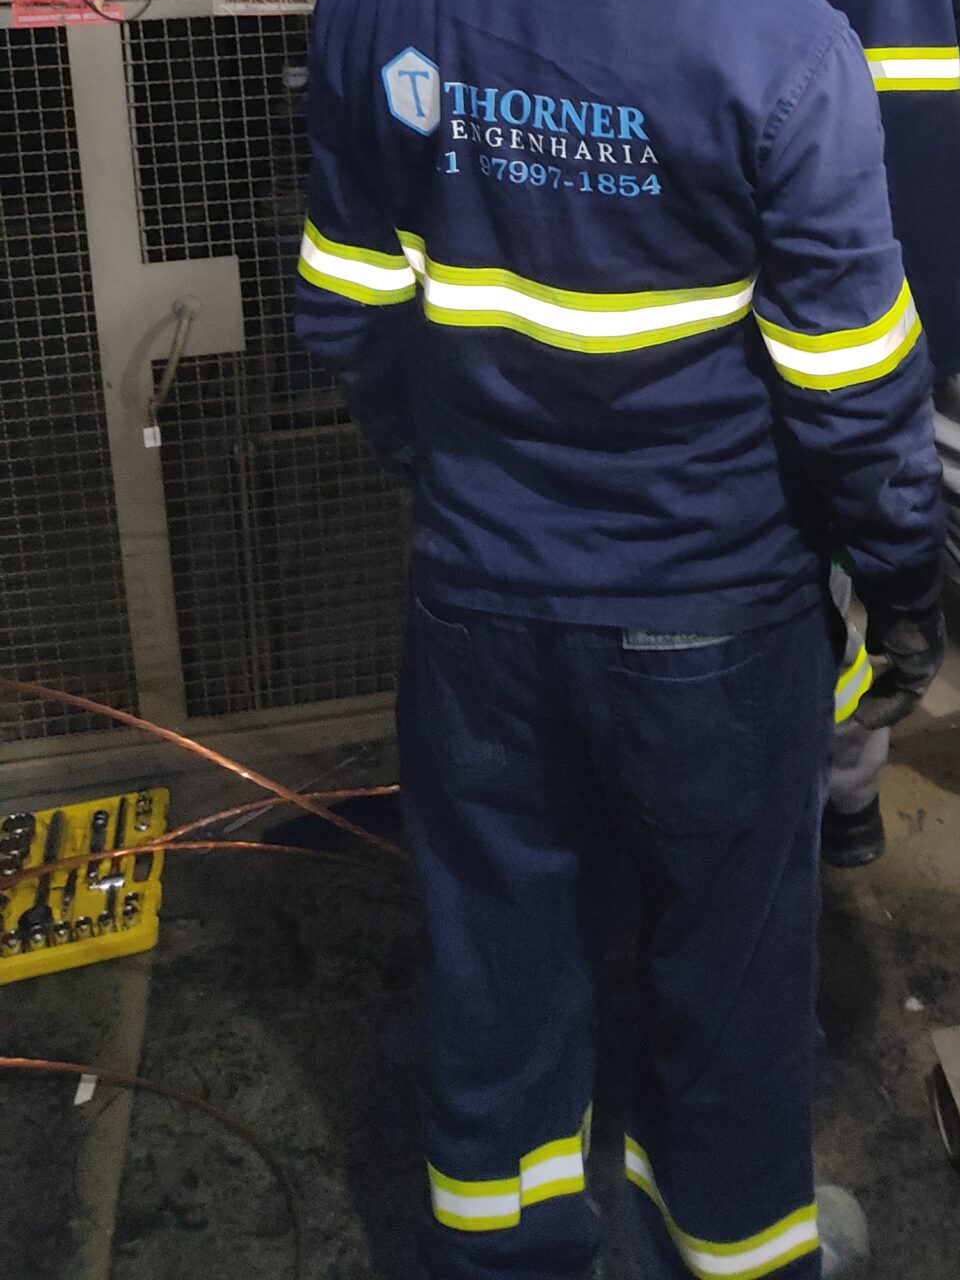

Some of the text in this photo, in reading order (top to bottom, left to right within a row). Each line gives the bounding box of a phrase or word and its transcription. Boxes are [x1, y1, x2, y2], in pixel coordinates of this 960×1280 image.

[444, 82, 650, 141] THORNER
[451, 120, 660, 164] ENGENHARIA
[479, 154, 662, 197] 97997-1854
